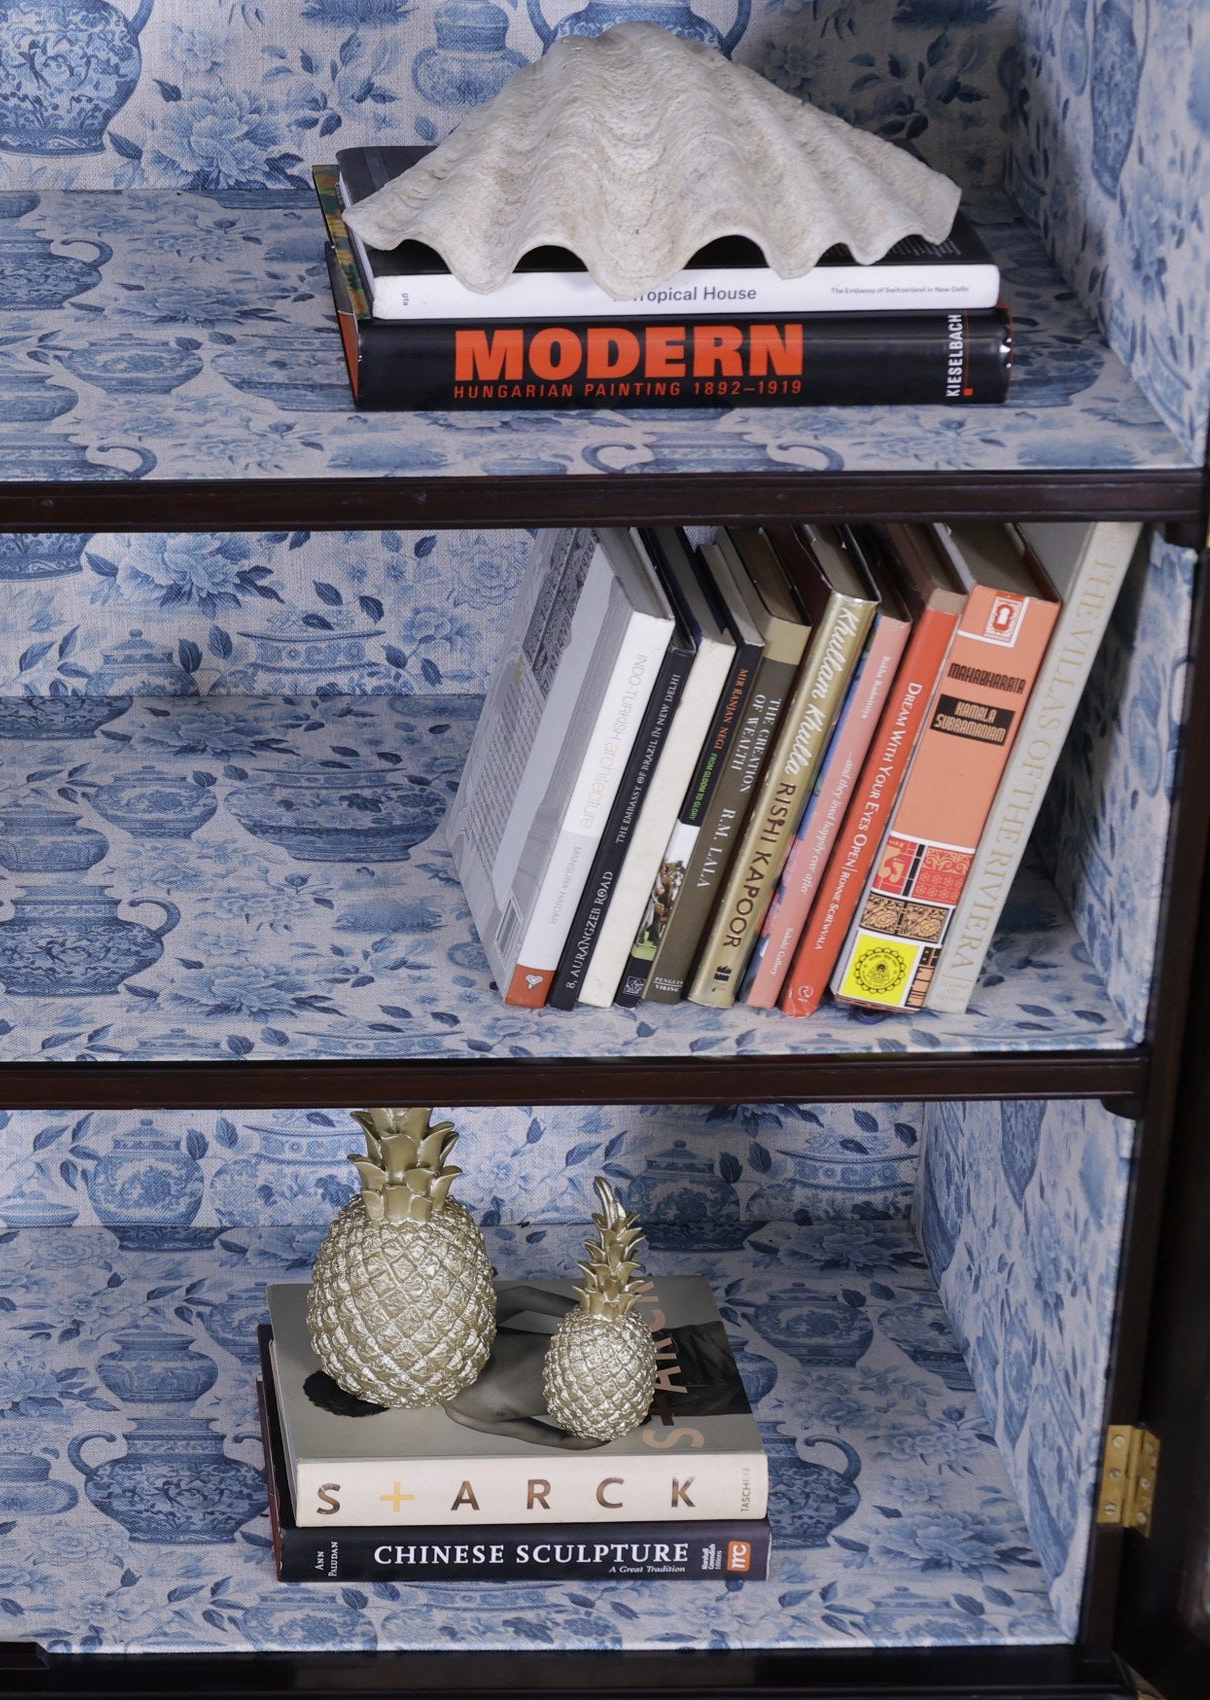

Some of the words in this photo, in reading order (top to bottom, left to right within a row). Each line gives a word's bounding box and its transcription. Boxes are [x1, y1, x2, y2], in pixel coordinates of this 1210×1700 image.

[633, 286, 697, 304] ropical
[703, 286, 757, 300] House
[454, 323, 804, 381] MODERN
[945, 313, 964, 397] KIESELBACH
[454, 383, 574, 399] HUNGARIAN
[585, 381, 682, 398] PAINTING
[1076, 557, 1118, 625] THE
[811, 606, 860, 699] Khullam
[664, 674, 681, 702] DELHI
[734, 668, 749, 687] MIR
[947, 662, 1027, 695] MAHABHARATA
[1037, 627, 1093, 733] VILLAS
[657, 703, 670, 727] NEW
[723, 686, 743, 724] RANJAN
[751, 693, 766, 714] OF
[766, 697, 782, 725] THE
[954, 701, 997, 724] KAMALA
[651, 727, 662, 739] IN
[714, 726, 730, 751] NEGI
[730, 716, 760, 771] WEALTH
[784, 703, 826, 776] Khulla
[934, 713, 1007, 743] SUBRAMANIAM
[641, 738, 659, 772] BRAZIL
[740, 727, 773, 793] CREATION
[1019, 738, 1052, 782] OF
[581, 742, 617, 829] architecture
[637, 772, 648, 785] OF
[832, 779, 848, 798] they
[623, 784, 643, 826] EMBASSY
[760, 782, 797, 843] RISHI
[1003, 782, 1039, 843] THE
[616, 825, 628, 844] THE
[713, 808, 737, 840] R.M.
[812, 821, 835, 854] happily
[697, 847, 723, 888] LALA
[800, 872, 814, 896] after
[722, 850, 773, 948] KAPOOR
[950, 845, 1013, 970] RIVIERA
[569, 907, 601, 978] AURANGZEB
[597, 870, 613, 906] ROAD
[741, 1468, 751, 1513] TASCHEN
[373, 1544, 504, 1565] CHINESE
[516, 1542, 689, 1564] SCULPTURE
[608, 1565, 617, 1573] A
[619, 1565, 644, 1573] Great
[646, 1564, 686, 1573] Tradition
